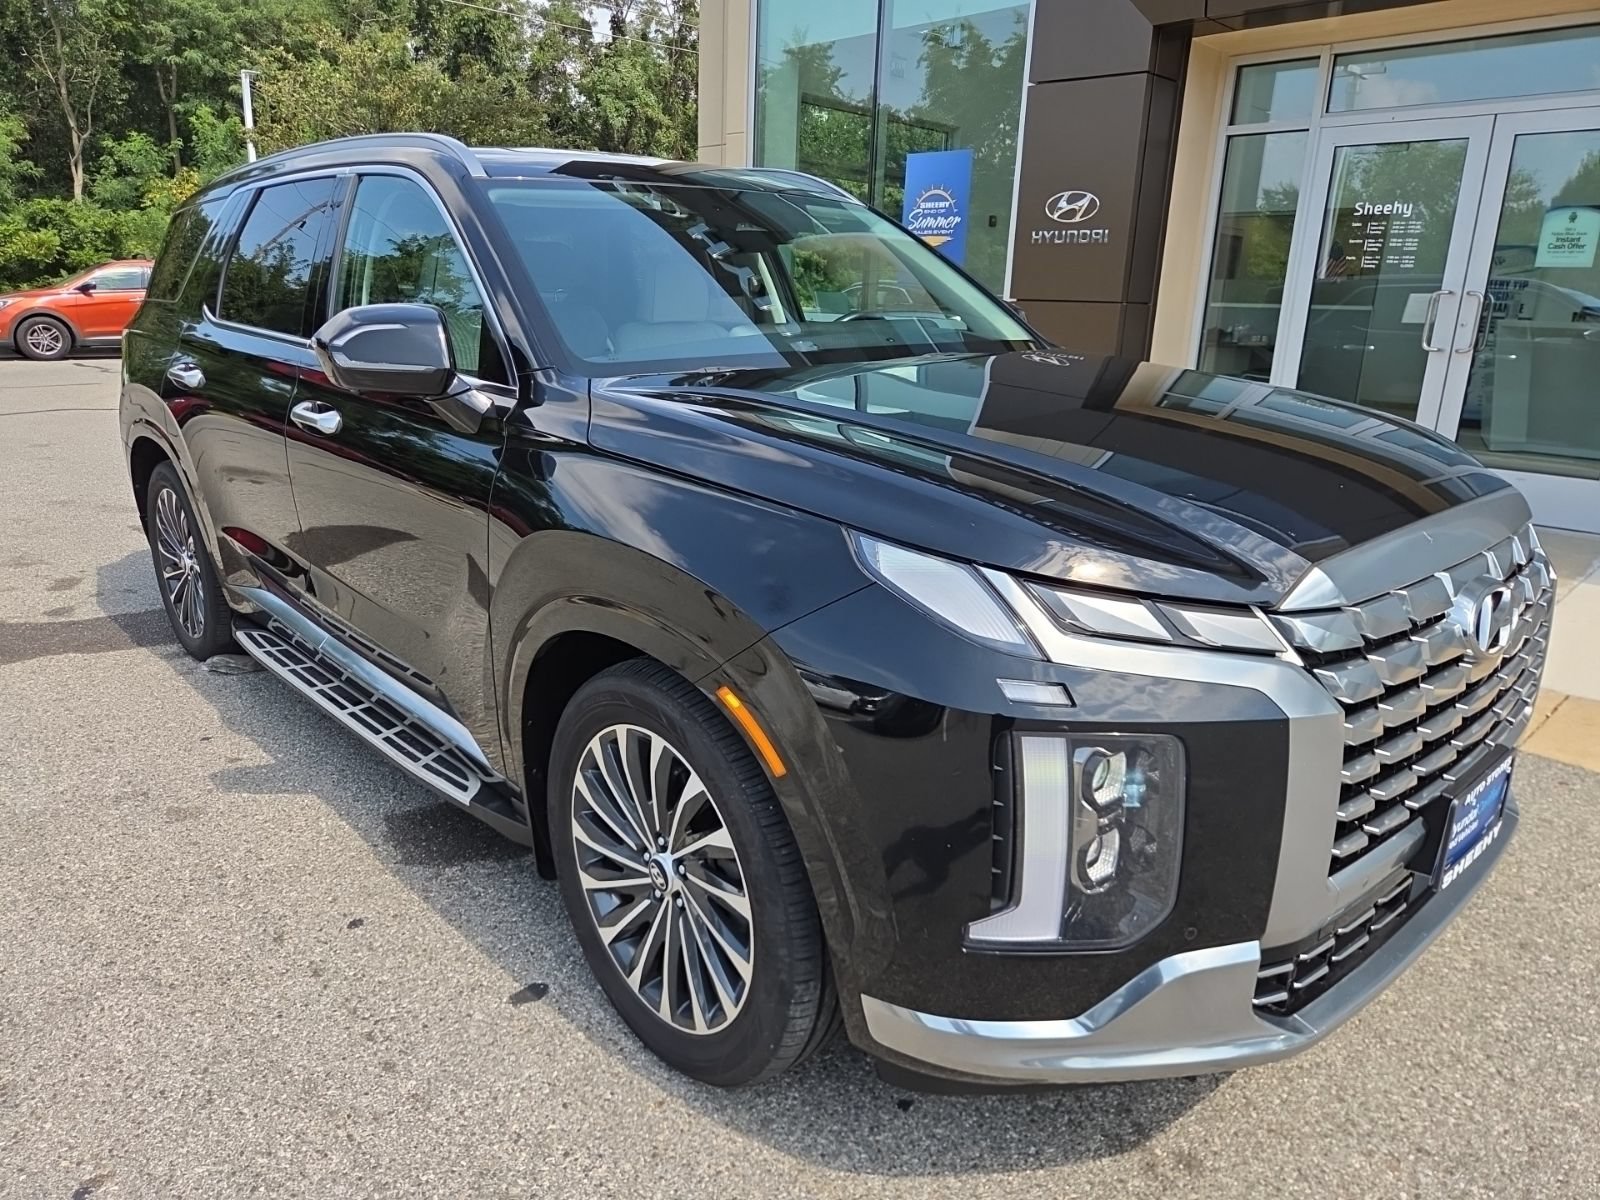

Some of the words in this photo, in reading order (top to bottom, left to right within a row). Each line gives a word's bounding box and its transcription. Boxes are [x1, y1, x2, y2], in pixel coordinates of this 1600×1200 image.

[920, 201, 950, 209] SHEEHY
[1353, 201, 1413, 217] Sheehy
[908, 209, 961, 229] Summer
[1032, 229, 1109, 244] HYUNDAI
[1441, 820, 1503, 889] SHEEHY
